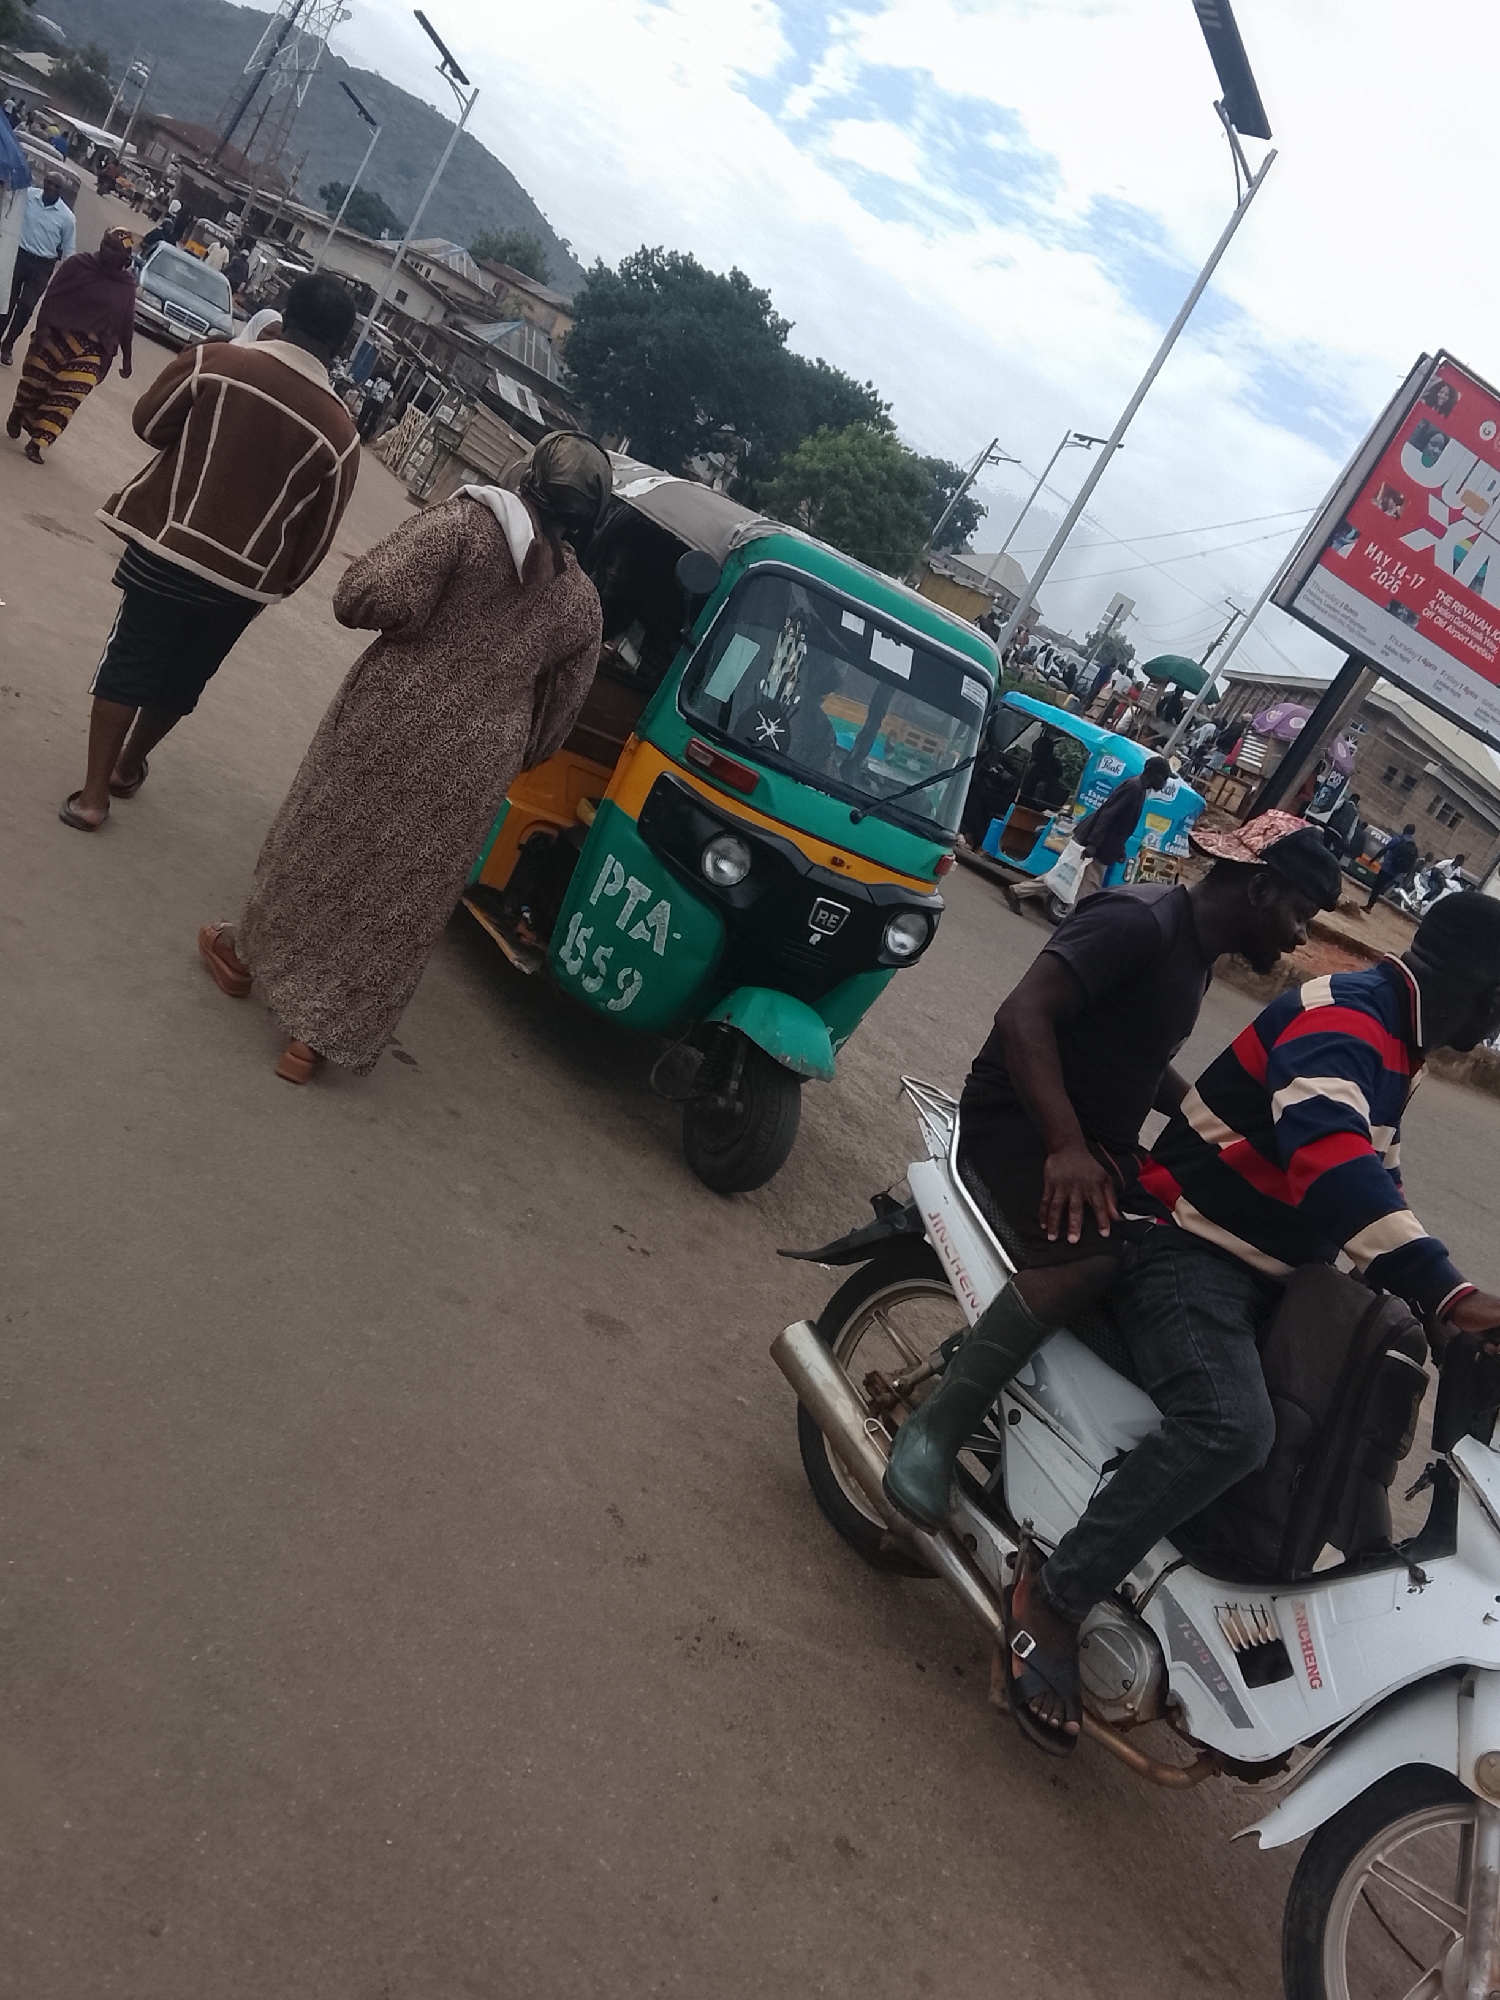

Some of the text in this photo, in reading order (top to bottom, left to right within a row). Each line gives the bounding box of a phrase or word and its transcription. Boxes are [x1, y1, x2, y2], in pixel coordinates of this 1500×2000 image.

[1364, 542, 1426, 590] MAY 14-17
[1370, 566, 1402, 594] 2026
[1435, 588, 1454, 607] THE
[1422, 608, 1434, 620] Off
[1434, 615, 1448, 628] Old
[1445, 625, 1470, 646] Airport
[1390, 634, 1419, 659] Thursday
[1422, 658, 1437, 671] 4pm
[814, 908, 840, 929] RE
[928, 1212, 981, 1318] JINCHEN
